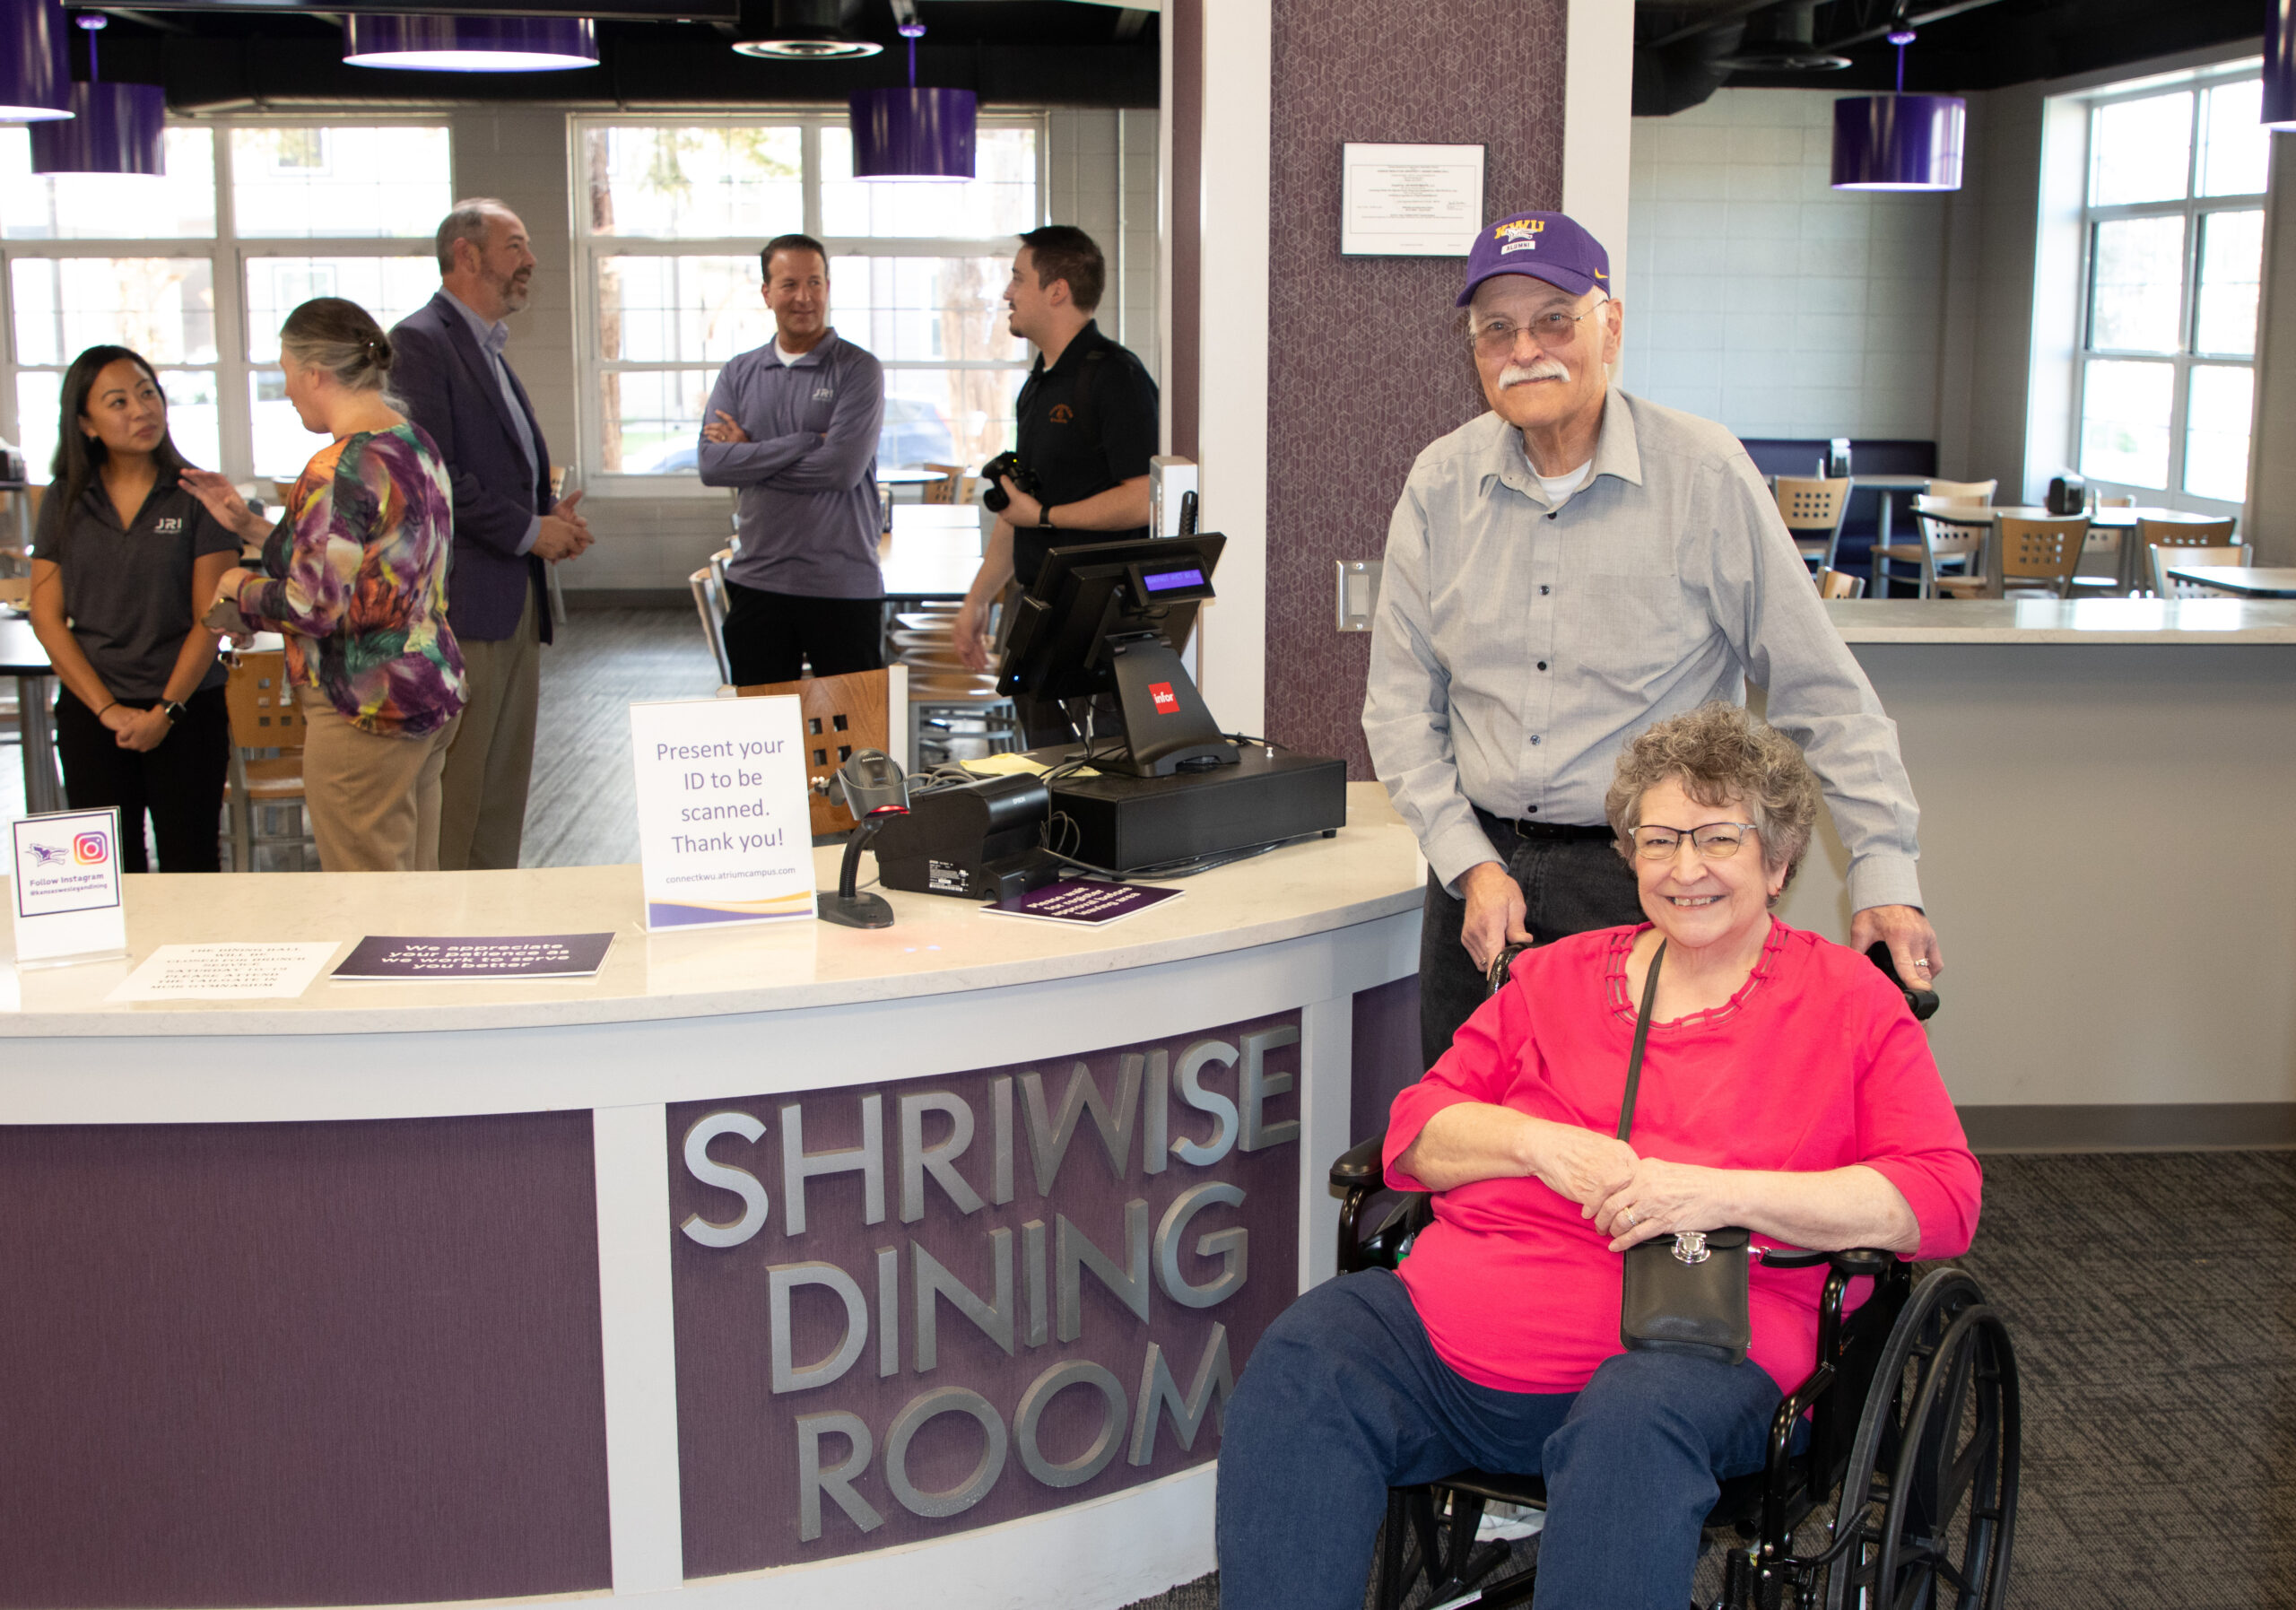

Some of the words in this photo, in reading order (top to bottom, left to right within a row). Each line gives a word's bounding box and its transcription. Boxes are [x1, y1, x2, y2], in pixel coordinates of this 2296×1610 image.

[1494, 219, 1545, 239] KWU
[1506, 242, 1531, 252] ALUMNI
[812, 388, 834, 398] JRI
[154, 518, 183, 530] JRI
[1153, 692, 1174, 704] infor
[656, 740, 734, 761] Present
[738, 738, 785, 761] your
[684, 772, 704, 790] ID
[711, 772, 732, 788] to
[738, 769, 763, 788] be
[681, 798, 770, 822] scanned.
[671, 832, 734, 854] Thank
[738, 828, 784, 853] you!
[30, 878, 58, 887] Follow
[61, 874, 104, 883] Instagram
[665, 866, 796, 883] connectkwu.atriumcampus.com
[447, 944, 563, 952] appreciate
[679, 1024, 1300, 1249] SHRIWISE
[765, 1181, 1248, 1395] DINING
[795, 1322, 1234, 1542] ROOM
